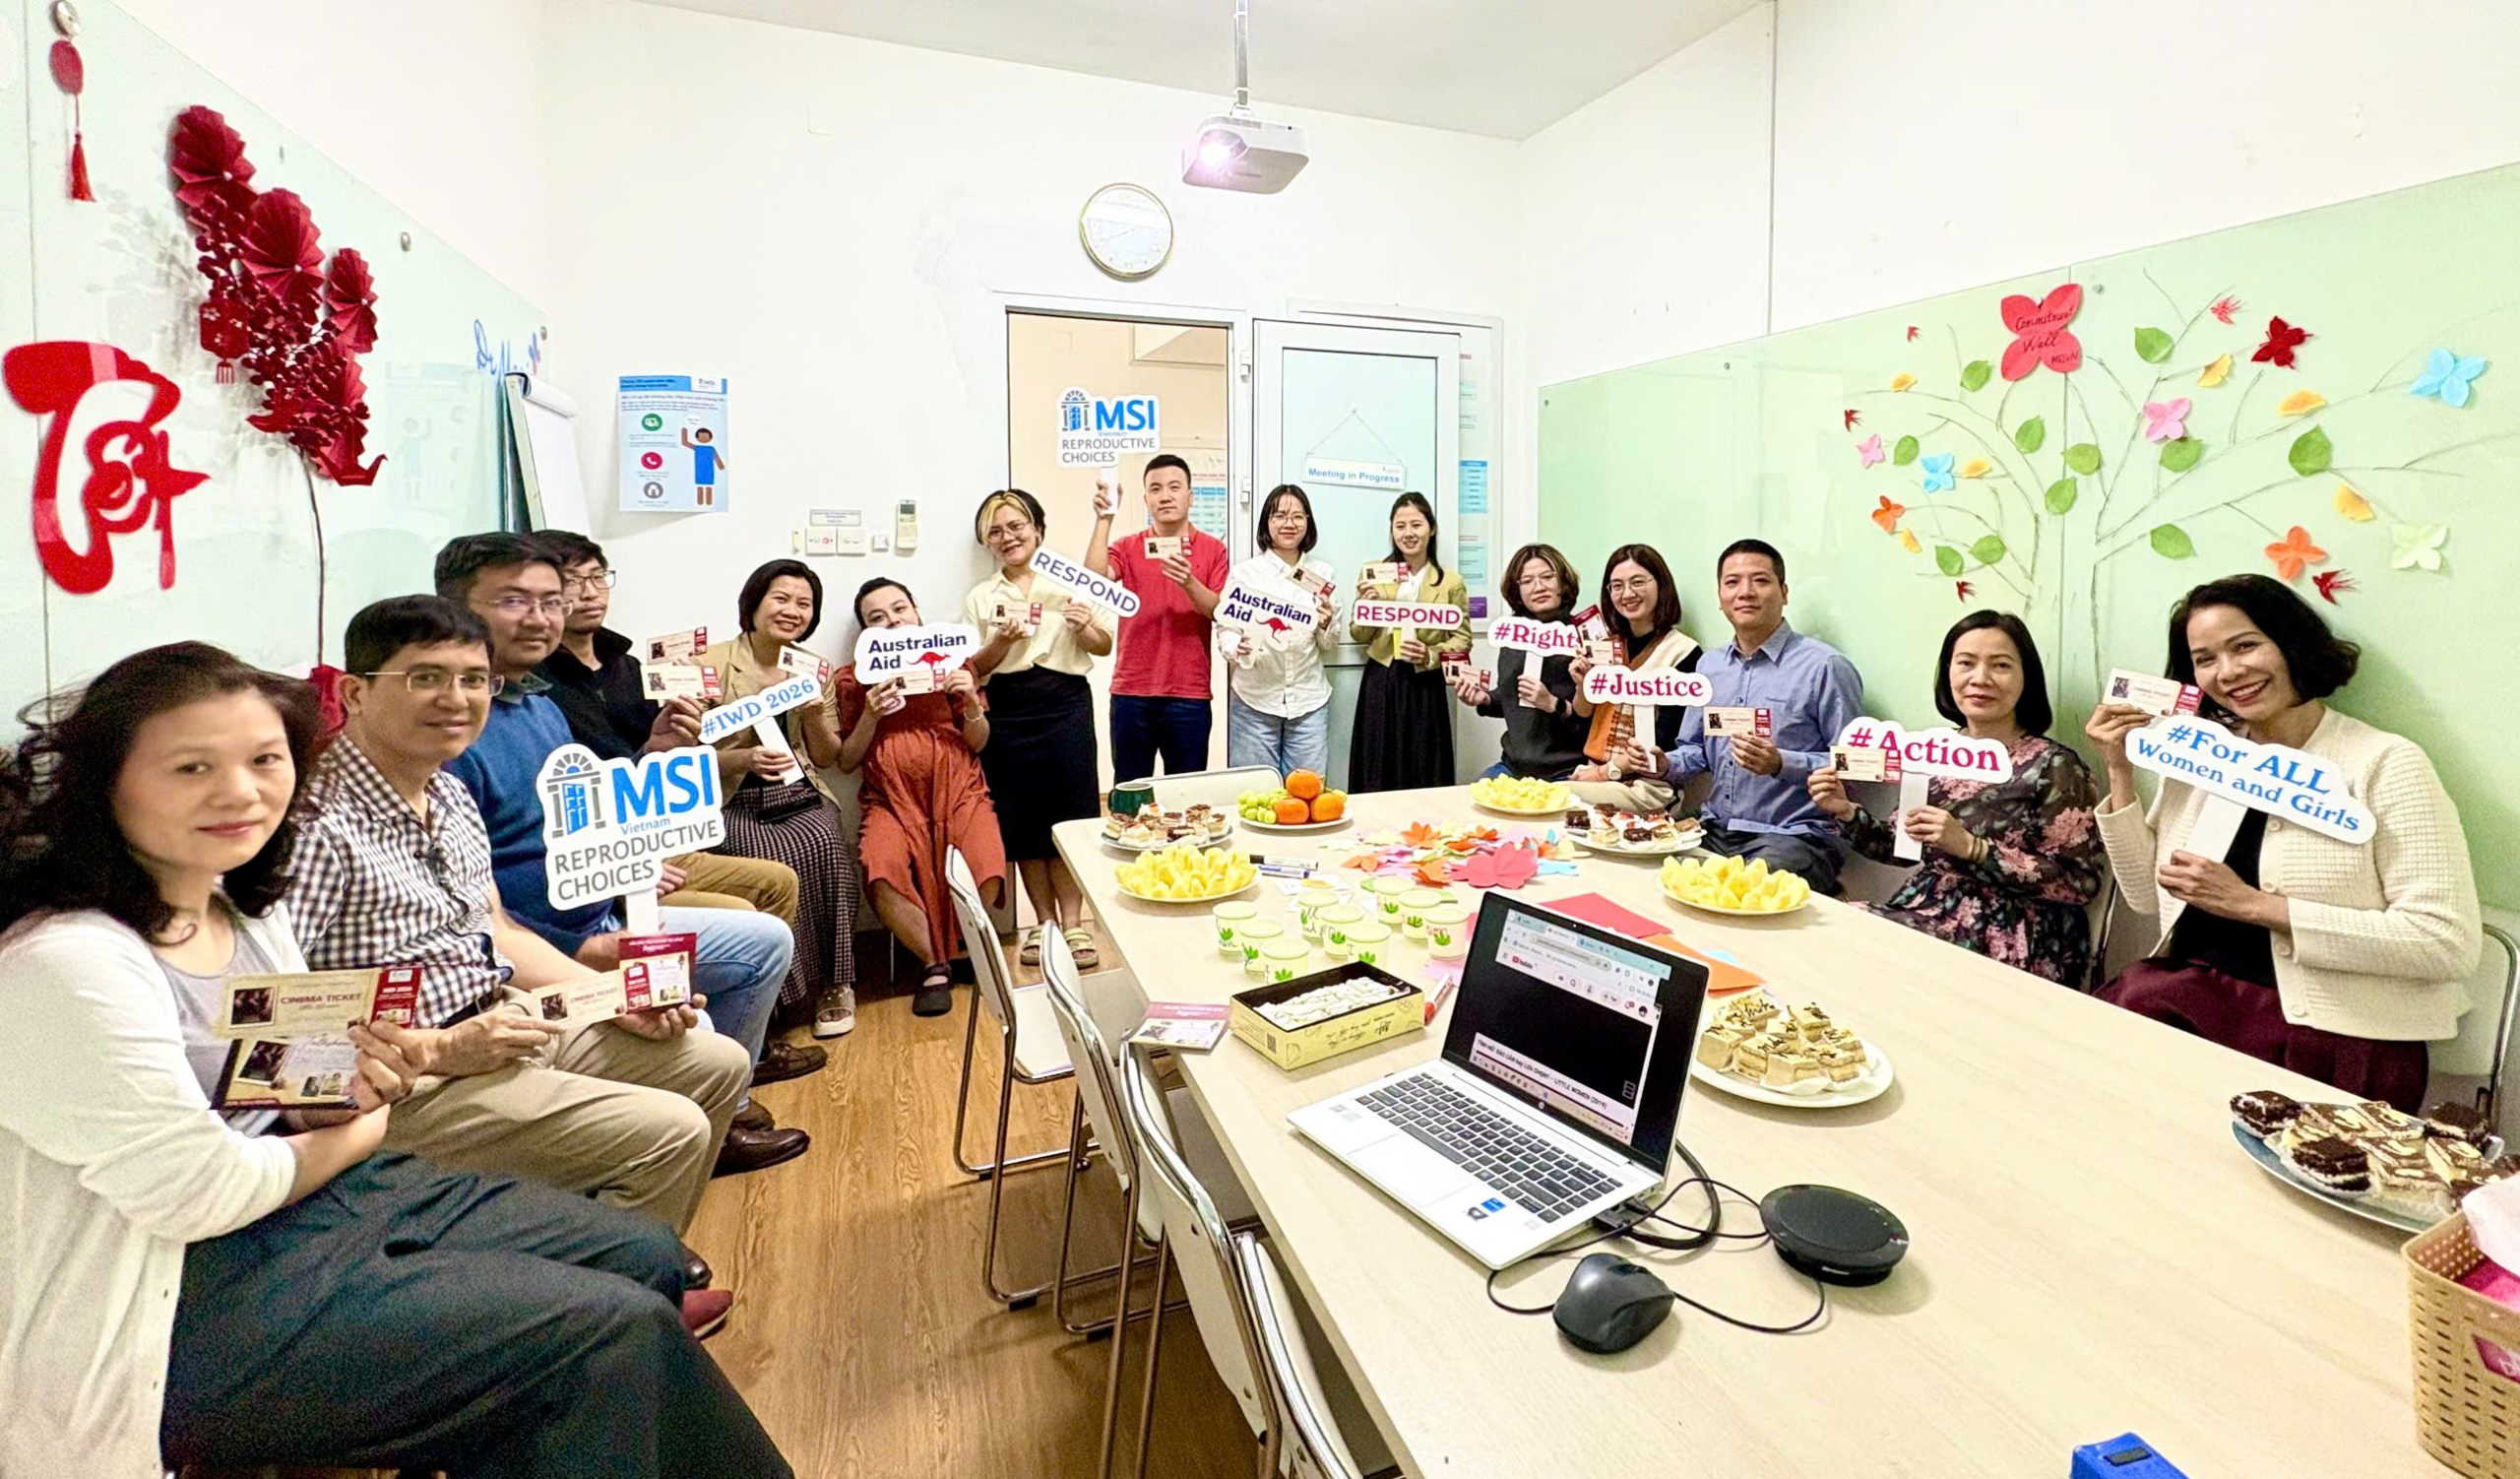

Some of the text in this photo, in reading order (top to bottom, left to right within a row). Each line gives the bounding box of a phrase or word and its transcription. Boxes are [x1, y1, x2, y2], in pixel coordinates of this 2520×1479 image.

[1096, 400, 1155, 431] MSI
[1062, 438, 1156, 450] REPRODUCTIVE
[1062, 452, 1115, 464] CHOICES
[1308, 468, 1346, 481] Meeting
[1359, 472, 1400, 483] Progress
[1034, 551, 1137, 612] RESPOND
[1223, 604, 1253, 622] Aid
[1228, 587, 1312, 624] Australian
[1356, 605, 1460, 624] RESPOND
[868, 633, 967, 654] Australian
[869, 655, 901, 671] Aid
[1591, 674, 1704, 697] #Justice
[703, 678, 814, 737] #IWD 2026
[1847, 727, 2000, 772] #Action
[2167, 724, 2331, 796] #For ALL
[611, 753, 715, 825] MSI
[2138, 738, 2360, 831] Women and Girls
[620, 817, 671, 835] Vietnam
[554, 819, 719, 874] REPRODUCTIVE
[557, 859, 655, 901] CHOICES
[280, 993, 362, 1004] CINEMA TICKET
